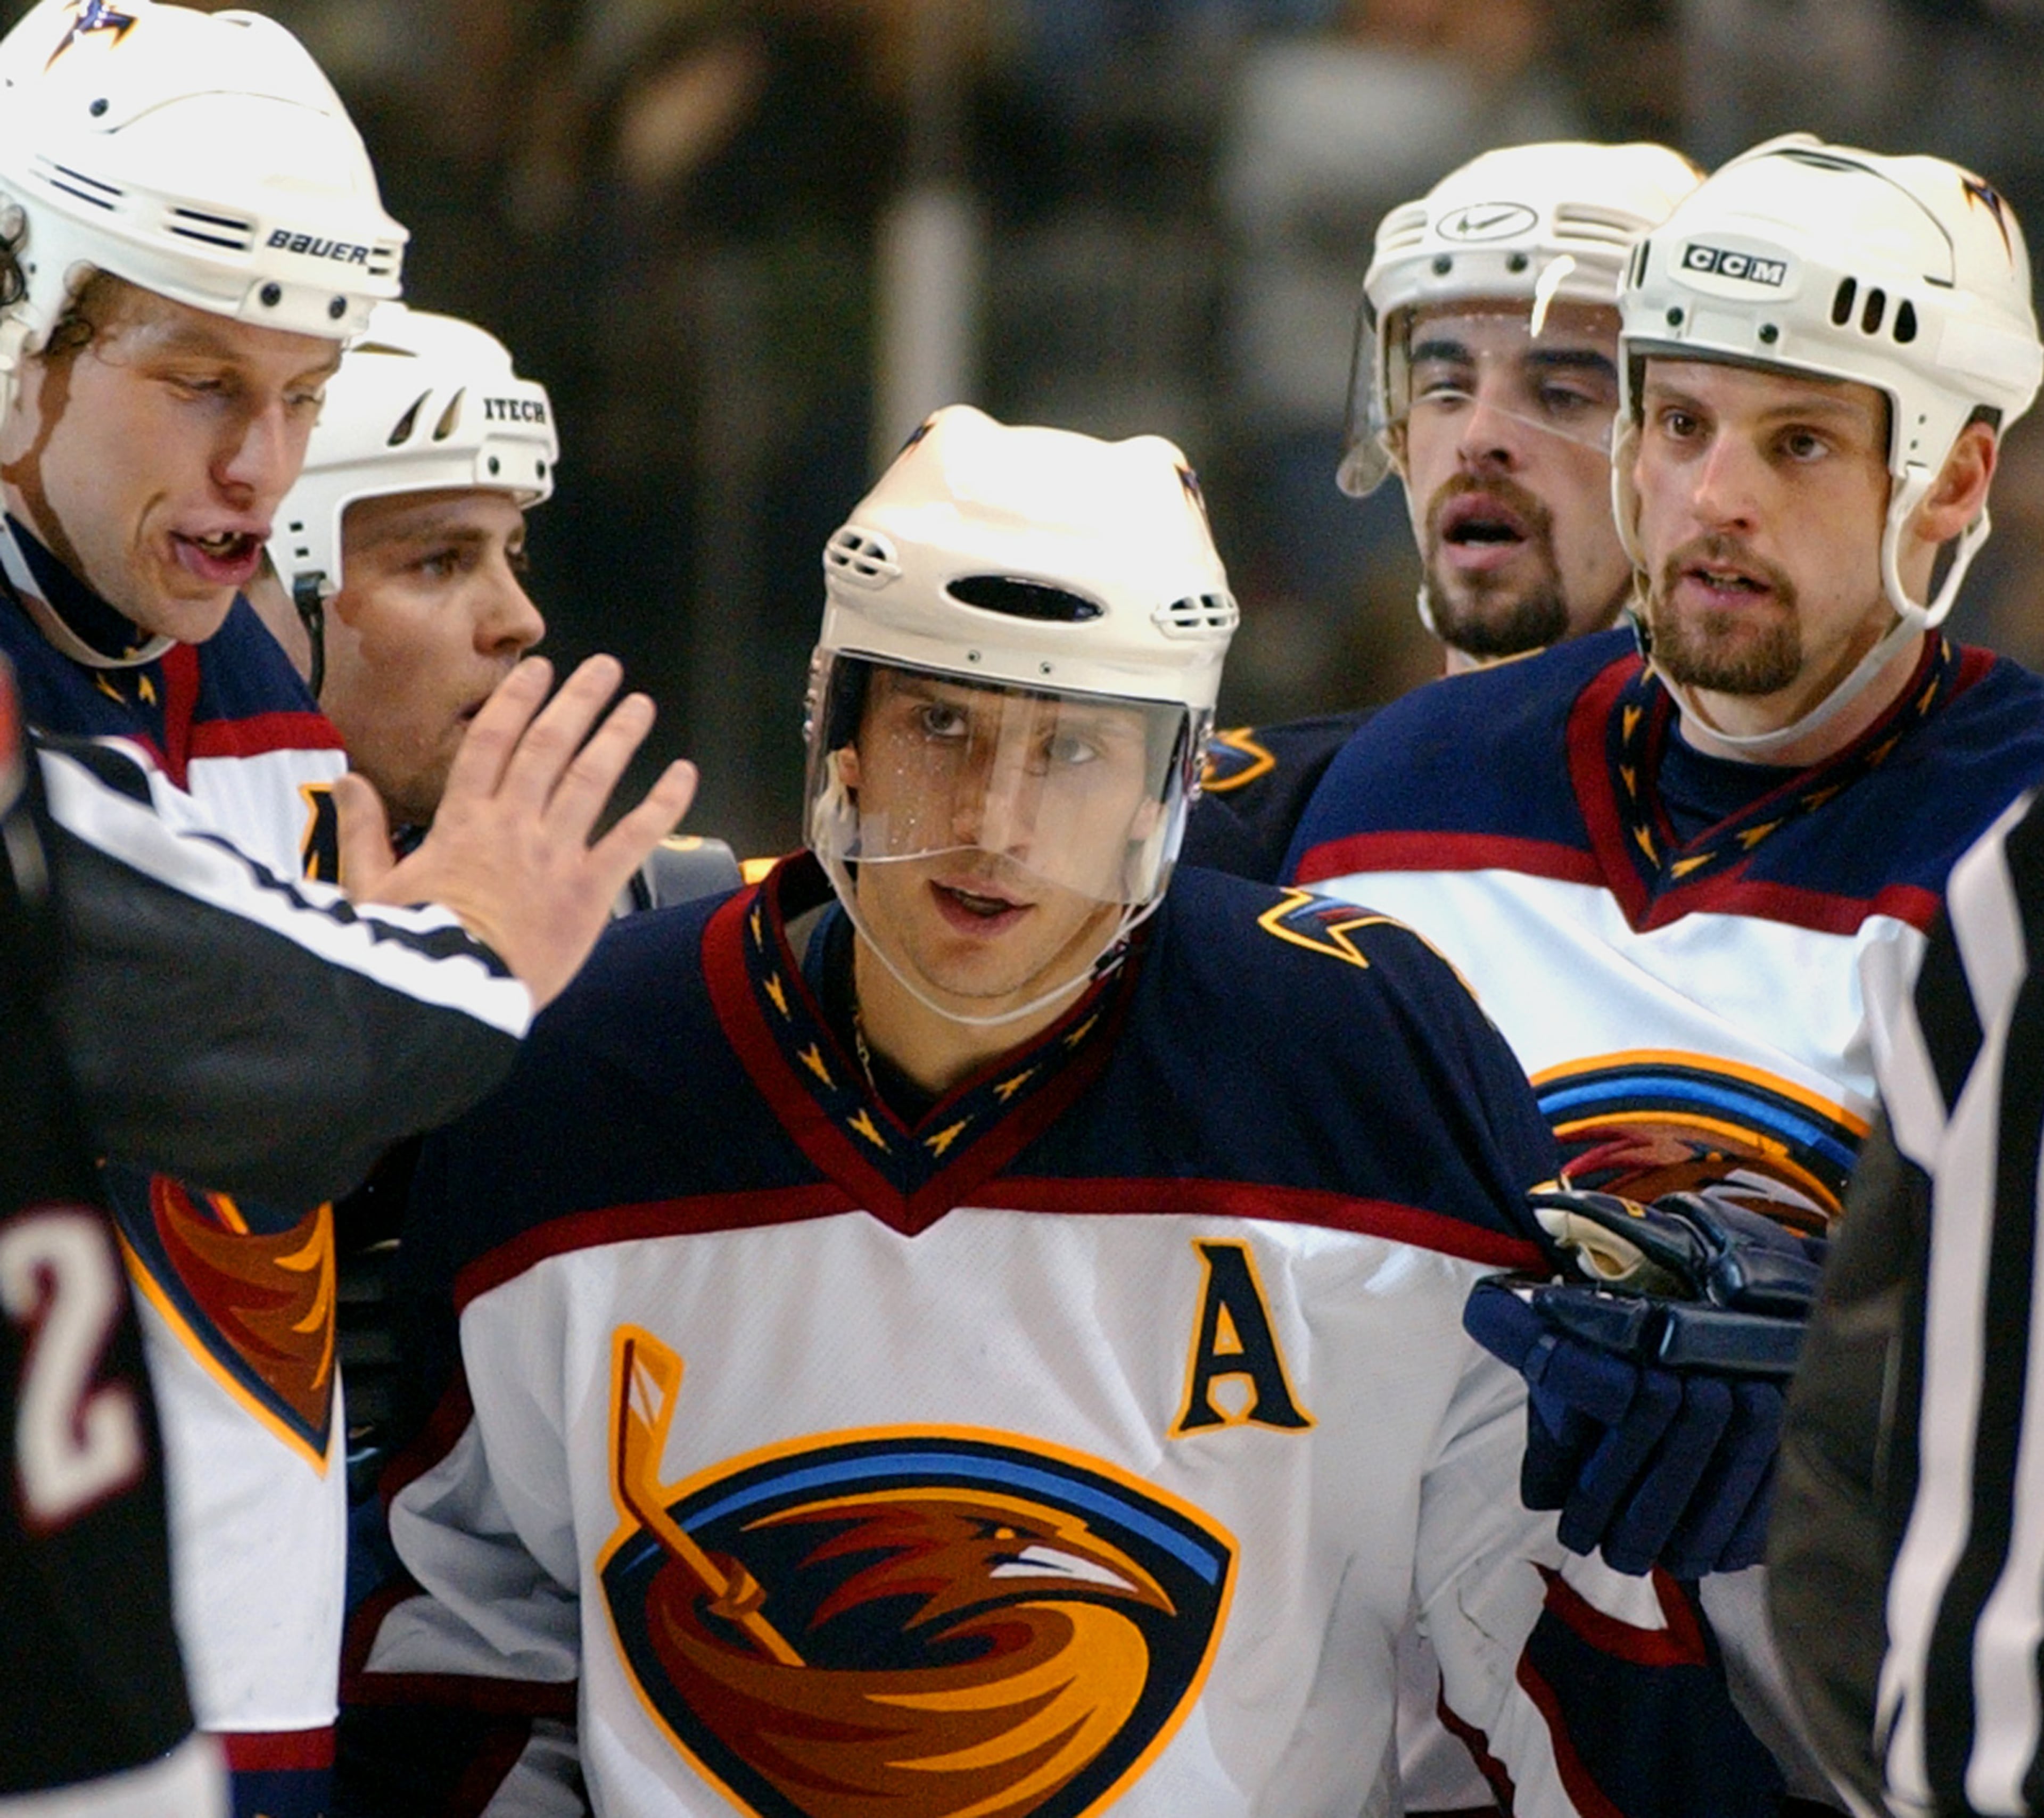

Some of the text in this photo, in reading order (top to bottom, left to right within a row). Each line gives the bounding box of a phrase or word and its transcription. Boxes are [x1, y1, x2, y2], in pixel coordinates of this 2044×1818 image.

[1686, 246, 1783, 284] CCM
[483, 398, 546, 424] ITECH
[0, 1204, 142, 1528] 2
[1167, 1237, 1318, 1440] A
